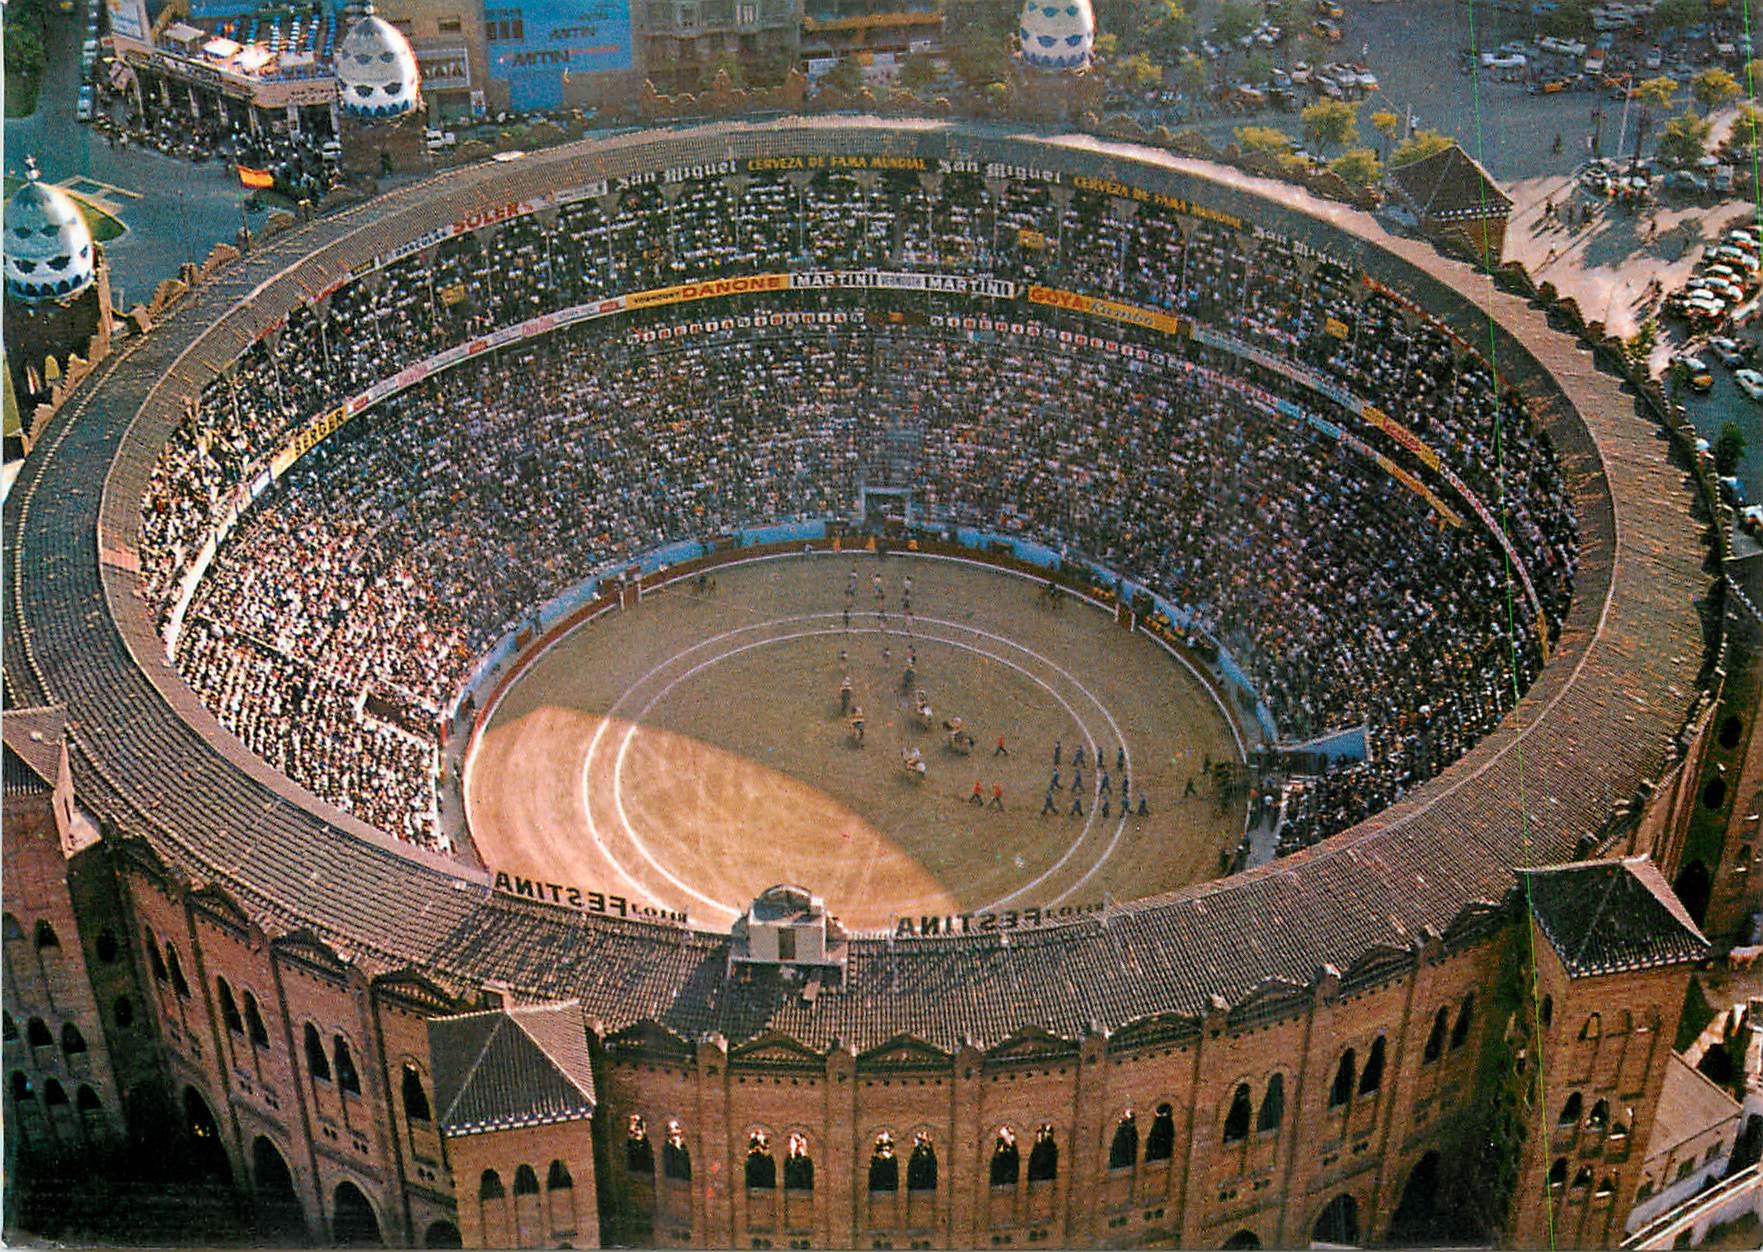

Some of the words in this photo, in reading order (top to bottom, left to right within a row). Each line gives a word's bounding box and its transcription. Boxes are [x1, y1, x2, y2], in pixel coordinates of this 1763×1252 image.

[747, 157, 803, 170] CERVEZA
[807, 156, 825, 168] DE
[830, 156, 866, 168] FAMA
[682, 276, 781, 299] DANONE
[799, 273, 876, 288] MARTINI
[930, 275, 1007, 297] MARTINI
